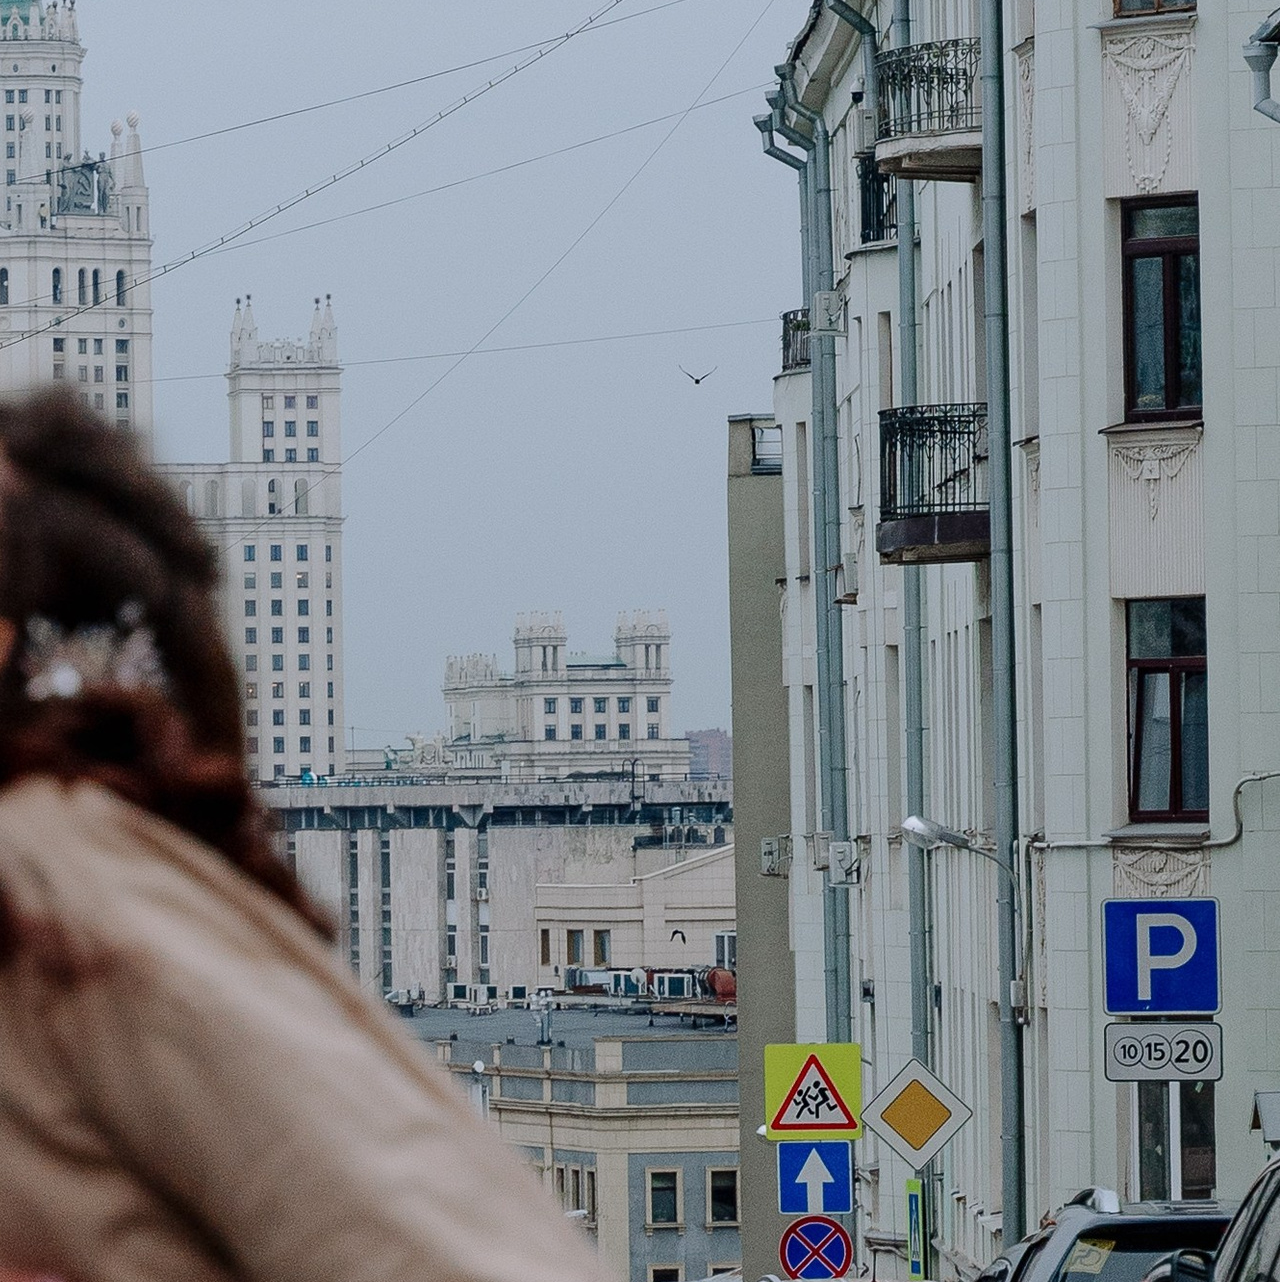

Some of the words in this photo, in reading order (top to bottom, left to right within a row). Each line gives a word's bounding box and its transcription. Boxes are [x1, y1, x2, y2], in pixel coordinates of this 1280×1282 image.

[1136, 913, 1197, 1000] P
[1120, 1044, 1138, 1060] 10
[1145, 1042, 1166, 1061] 15
[1174, 1039, 1209, 1063] 20
